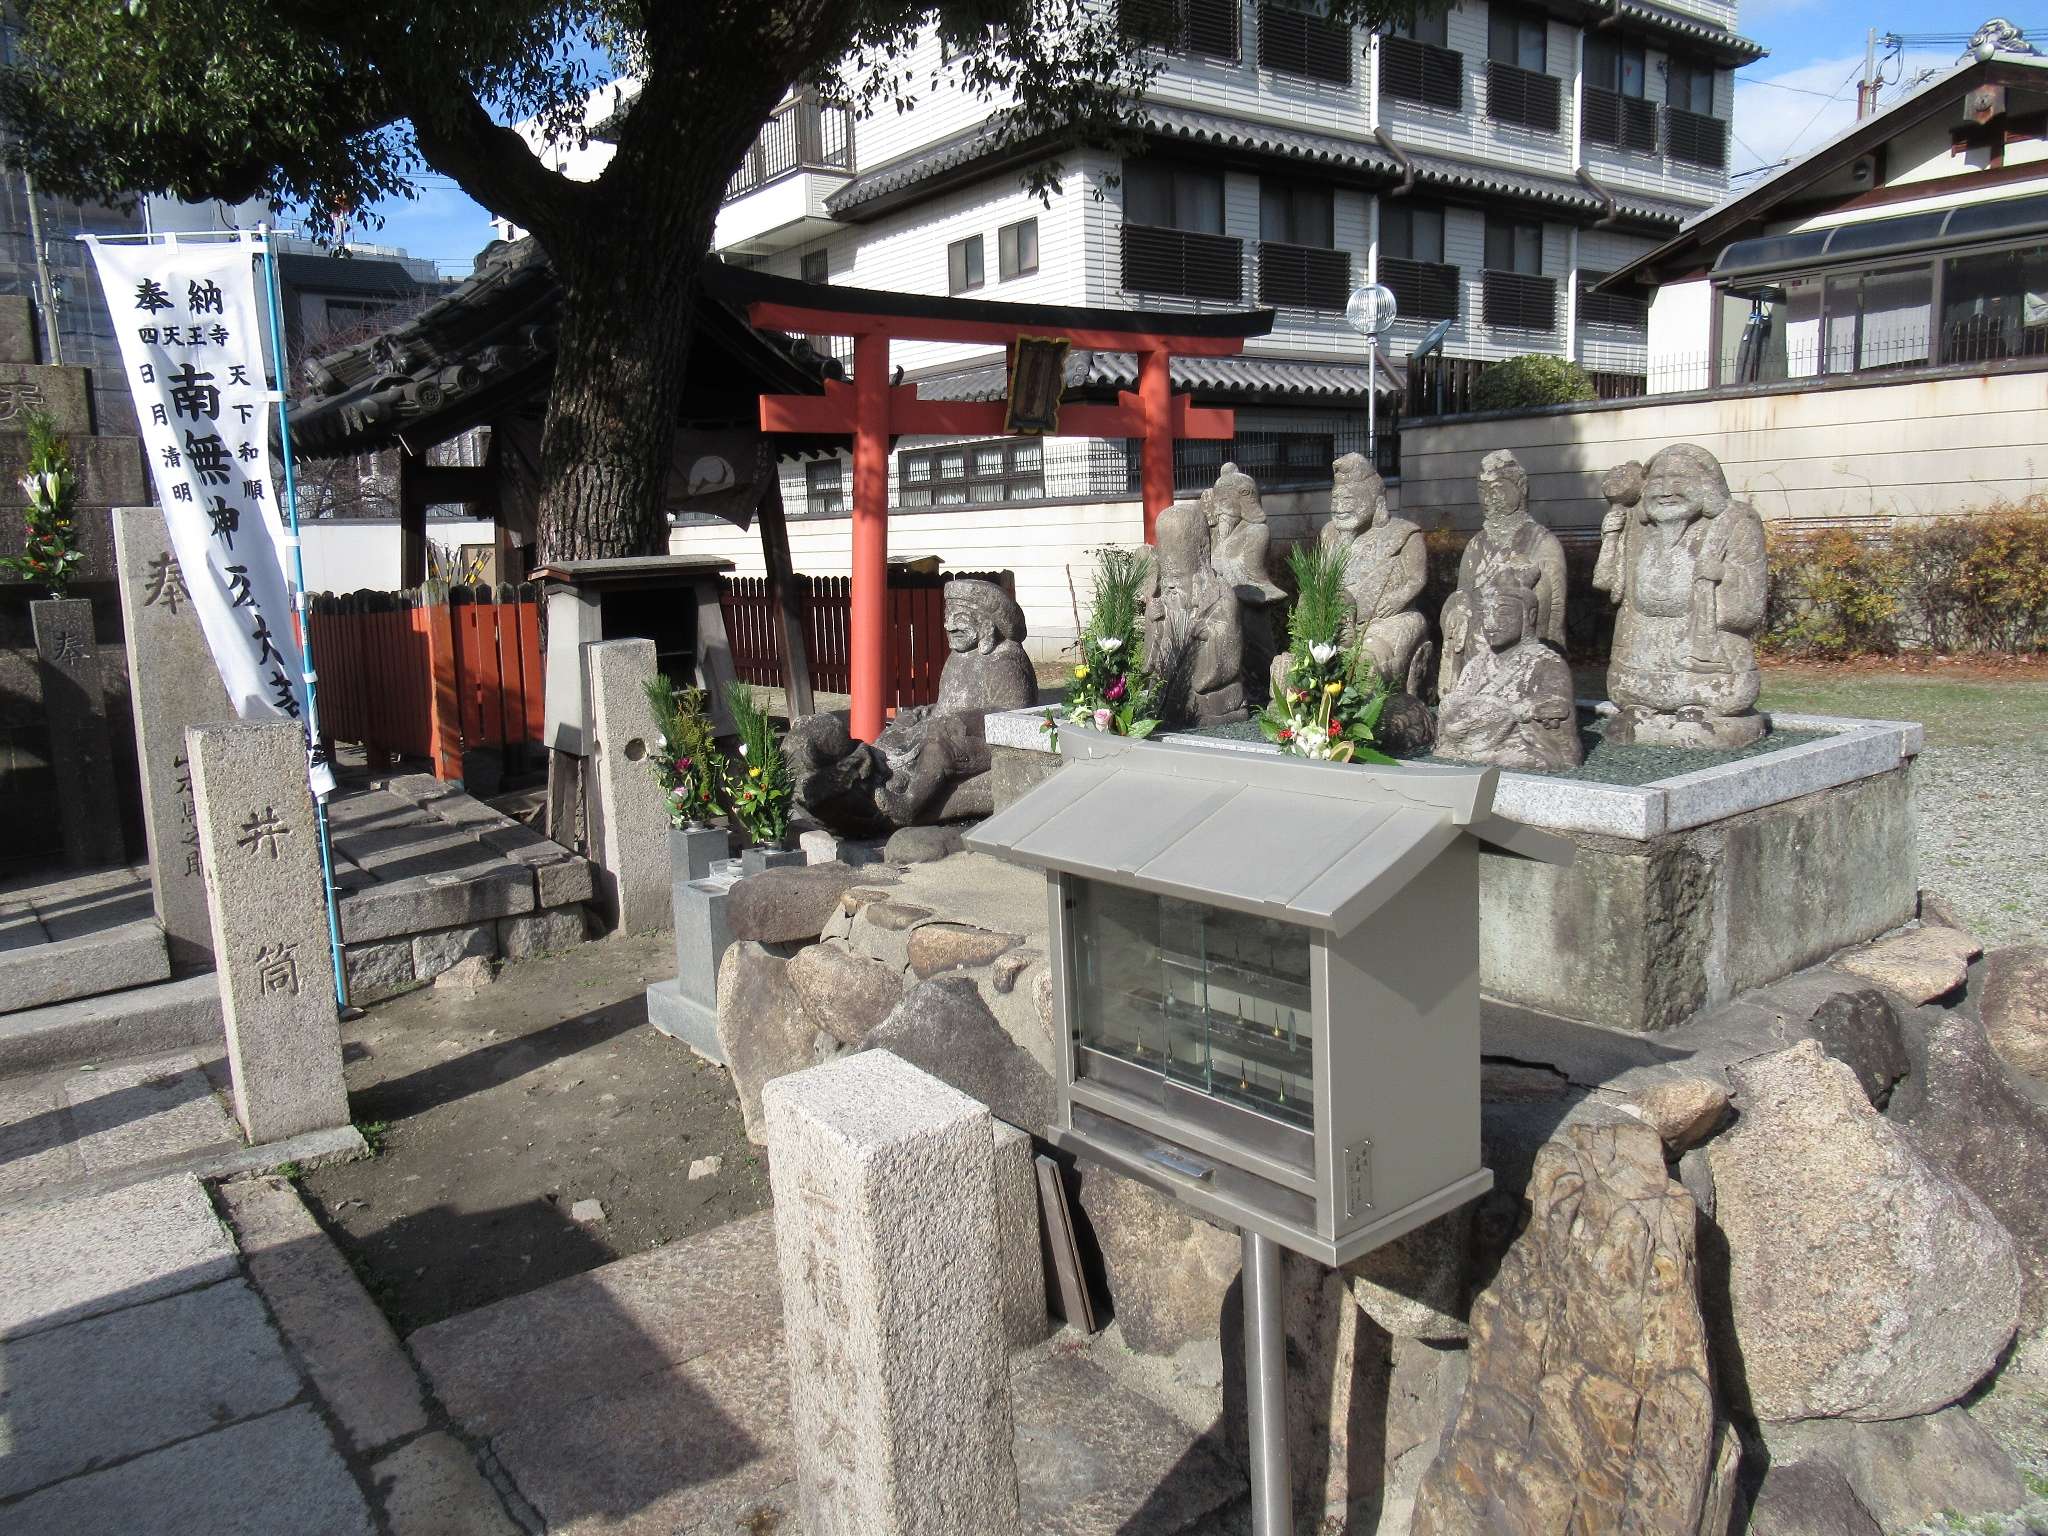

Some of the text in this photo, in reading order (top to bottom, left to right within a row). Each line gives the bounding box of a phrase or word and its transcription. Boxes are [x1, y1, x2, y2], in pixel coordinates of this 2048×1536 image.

[134, 277, 224, 316] 奉納
[138, 323, 230, 347] 四天王寺
[139, 363, 193, 503] 日月清明
[227, 364, 265, 501] 天下和順
[236, 805, 299, 997] 井筒
